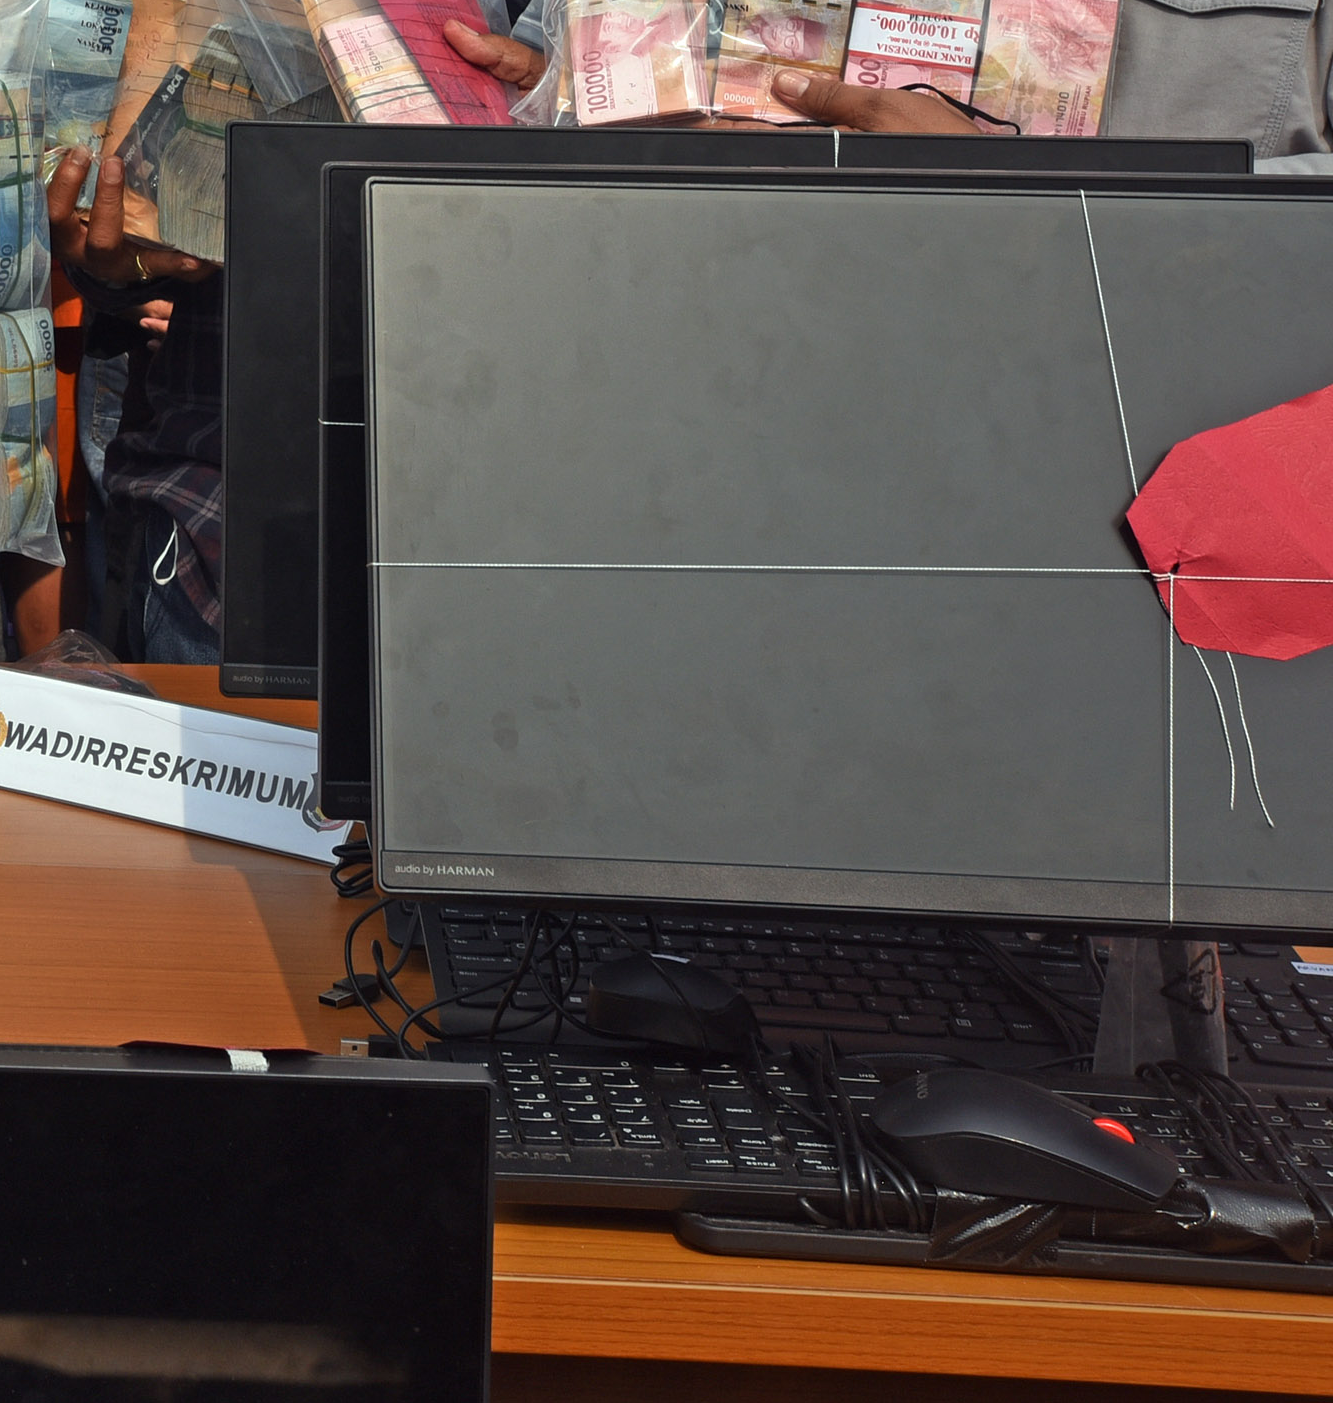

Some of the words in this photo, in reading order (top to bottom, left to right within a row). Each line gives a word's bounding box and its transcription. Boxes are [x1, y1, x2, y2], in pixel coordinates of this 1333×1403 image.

[876, 42, 938, 61] INDONESIA
[938, 53, 973, 66] BANK
[165, 72, 185, 97] BCA
[583, 49, 608, 116] 100000
[232, 674, 253, 683] audio
[254, 675, 264, 685] by
[265, 674, 311, 686] HARMAN
[4, 720, 308, 811] WADIRRESKRIMUM
[394, 863, 421, 875] audio
[422, 864, 435, 877] by
[436, 864, 495, 878] HARMAN
